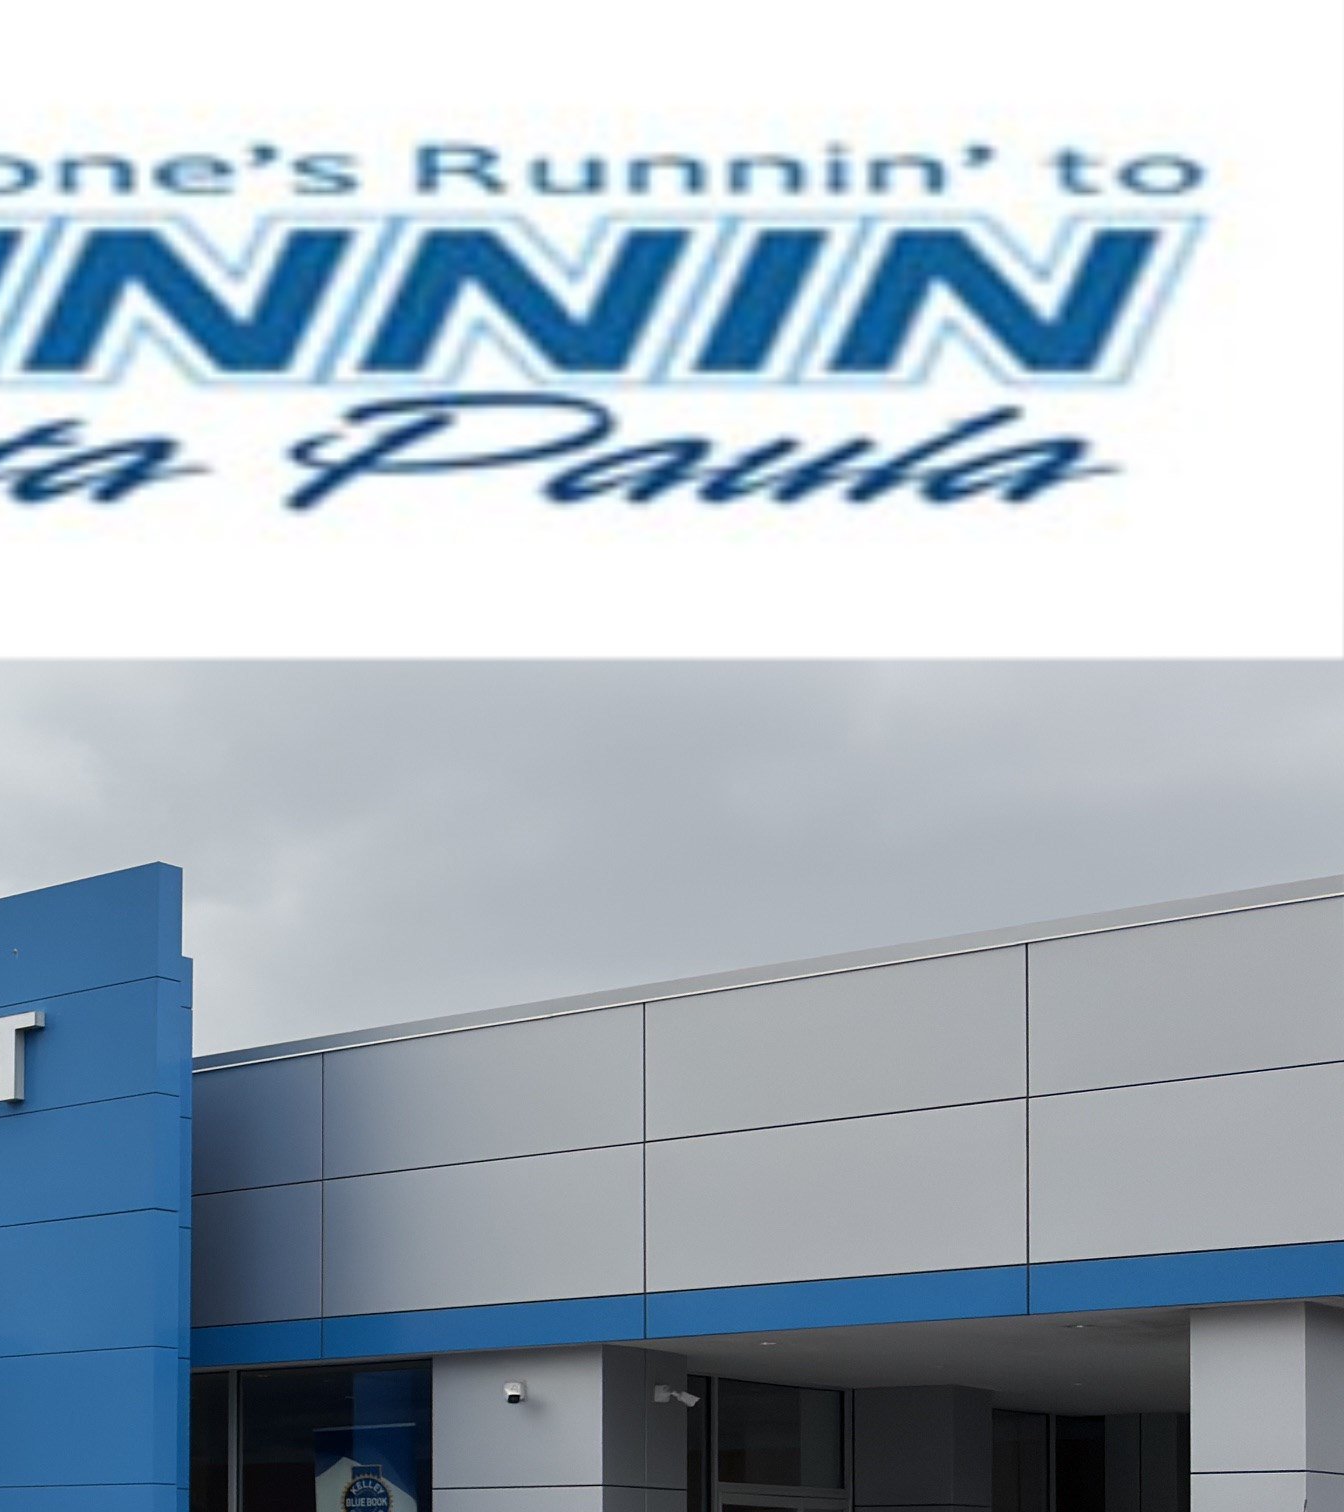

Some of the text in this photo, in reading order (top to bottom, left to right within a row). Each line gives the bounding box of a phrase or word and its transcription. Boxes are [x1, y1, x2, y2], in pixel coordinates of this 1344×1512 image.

[349, 1480, 386, 1495] KELLEY
[345, 1497, 388, 1507] BLUE BOOK
